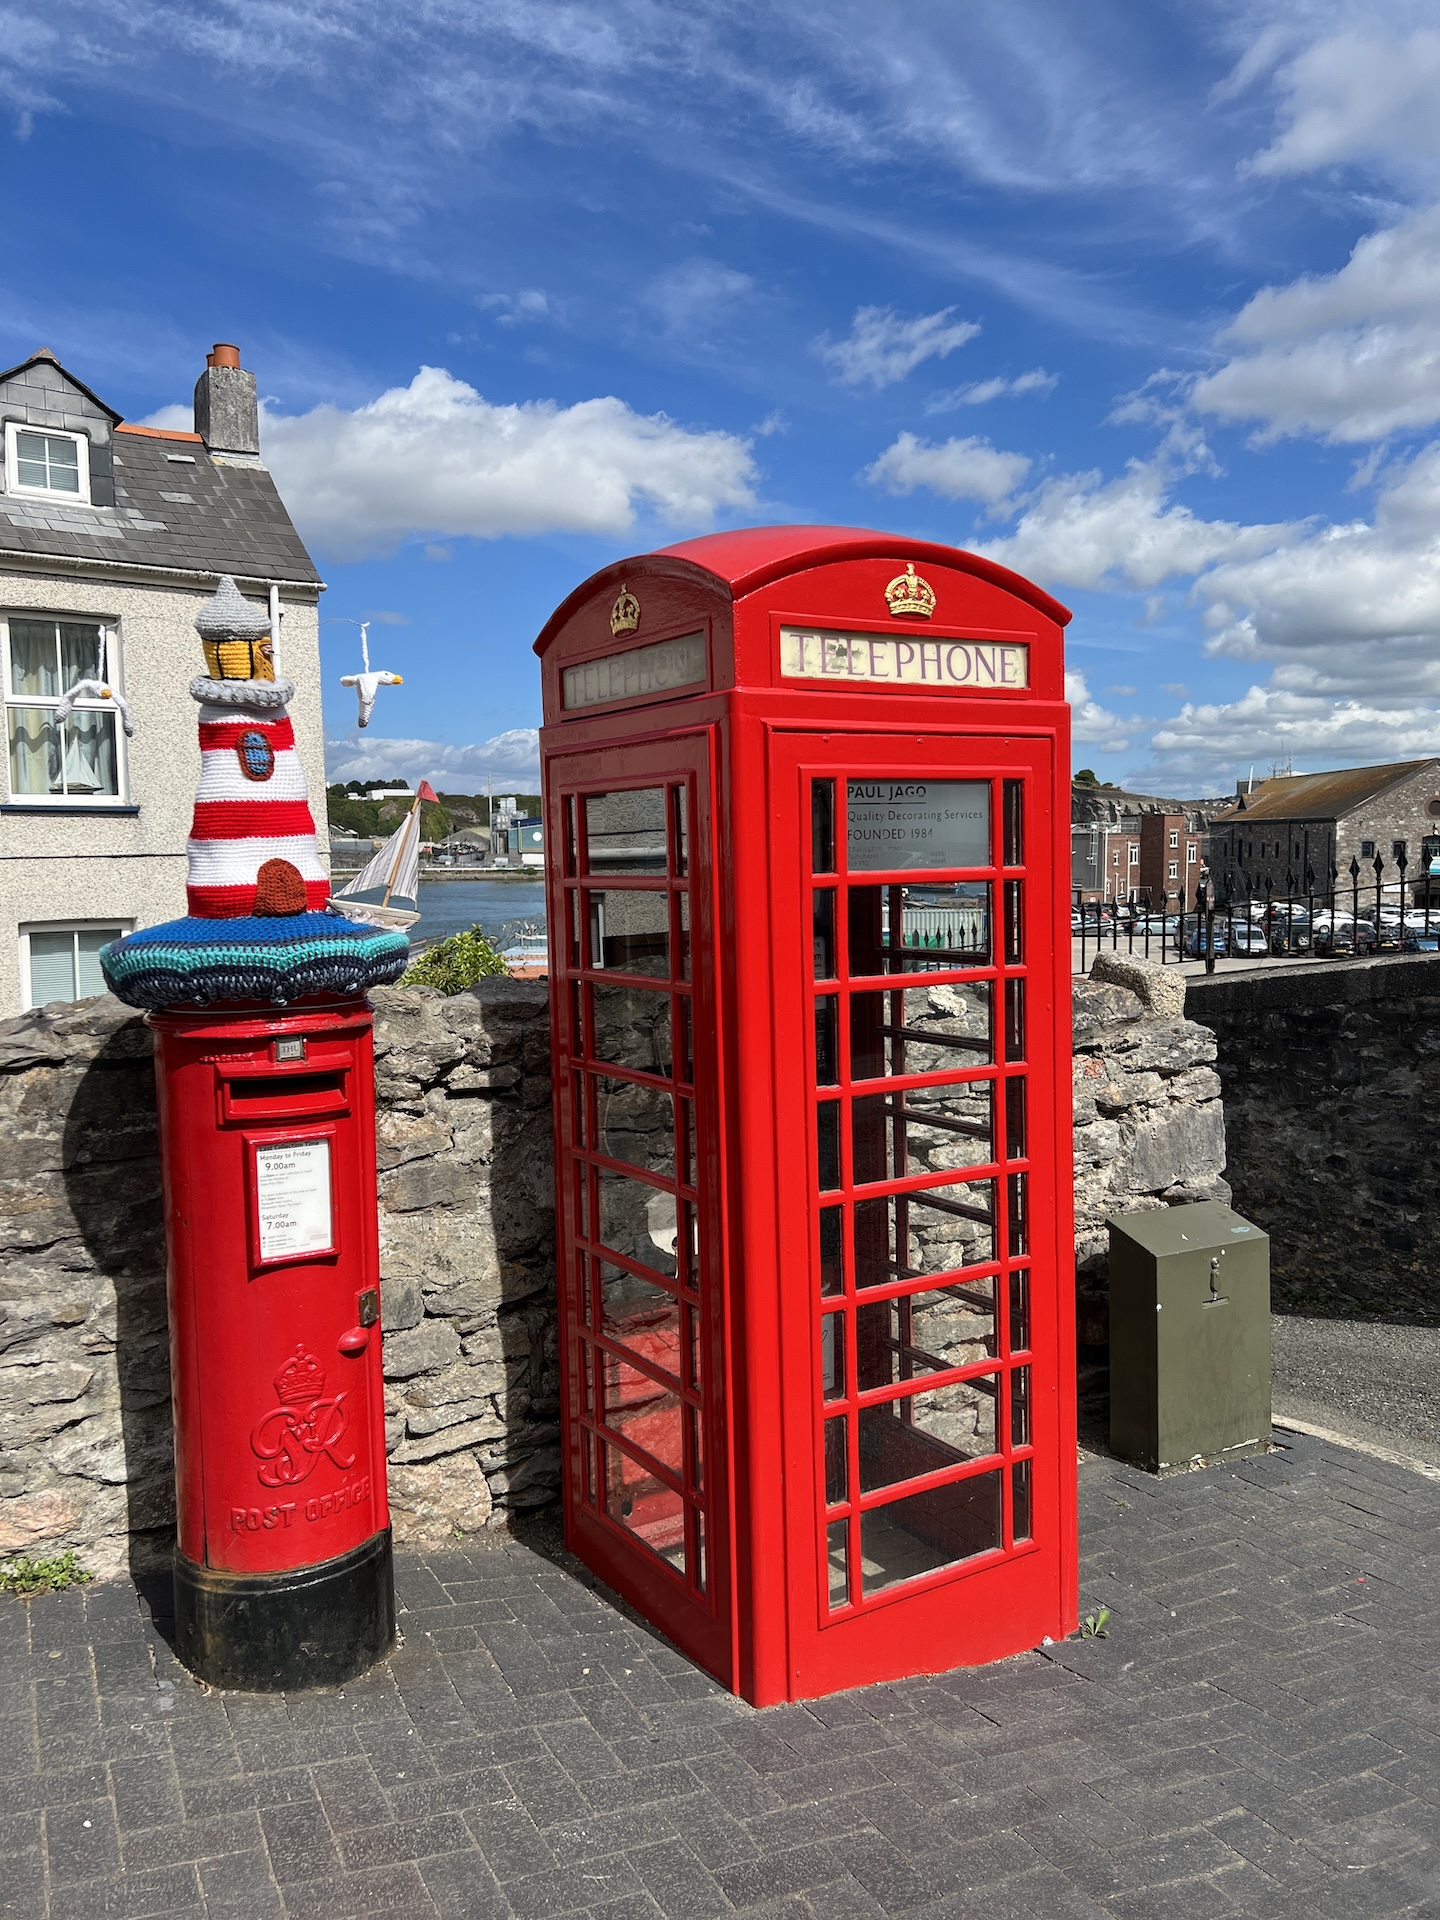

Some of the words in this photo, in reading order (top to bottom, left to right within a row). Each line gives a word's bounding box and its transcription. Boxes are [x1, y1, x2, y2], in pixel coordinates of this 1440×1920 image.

[790, 634, 1017, 684] TELEPHONE
[847, 785, 884, 799] PAUL
[889, 785, 927, 801] JAGO
[847, 810, 885, 823] Quality
[888, 810, 942, 823] Decorating
[944, 809, 983, 821] Services
[847, 828, 906, 841] FOUNDED
[911, 828, 933, 840] 1984
[281, 1044, 300, 1054] THU
[274, 1141, 304, 1151] Collection
[260, 1153, 283, 1162] Monday
[293, 1150, 312, 1159] Friday
[265, 1161, 296, 1172] 9.00am
[261, 1212, 289, 1222] Saturday
[267, 1220, 297, 1231] 7.00am
[305, 1475, 371, 1522] OFFICE
[230, 1502, 296, 1532] POST
